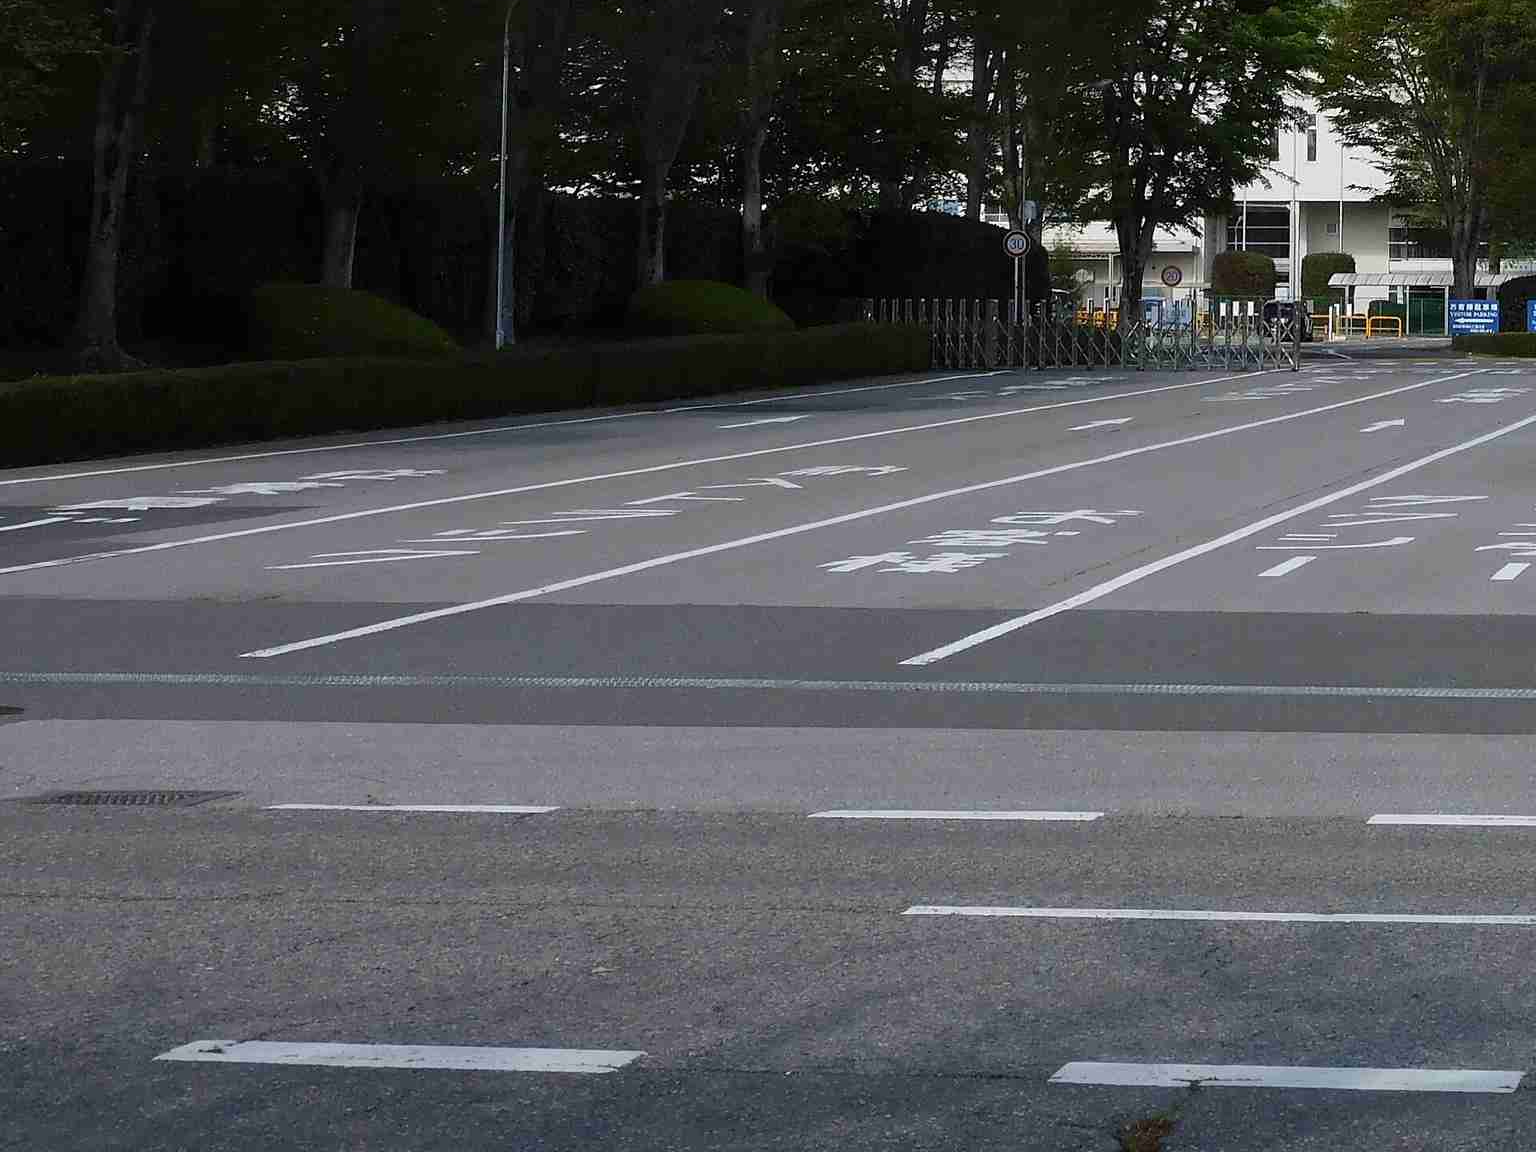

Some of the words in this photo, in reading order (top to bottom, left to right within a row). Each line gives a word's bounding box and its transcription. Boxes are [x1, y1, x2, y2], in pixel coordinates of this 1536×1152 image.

[1007, 239, 1025, 250] 30
[1165, 271, 1178, 281] 20
[817, 509, 1145, 573] お客様
